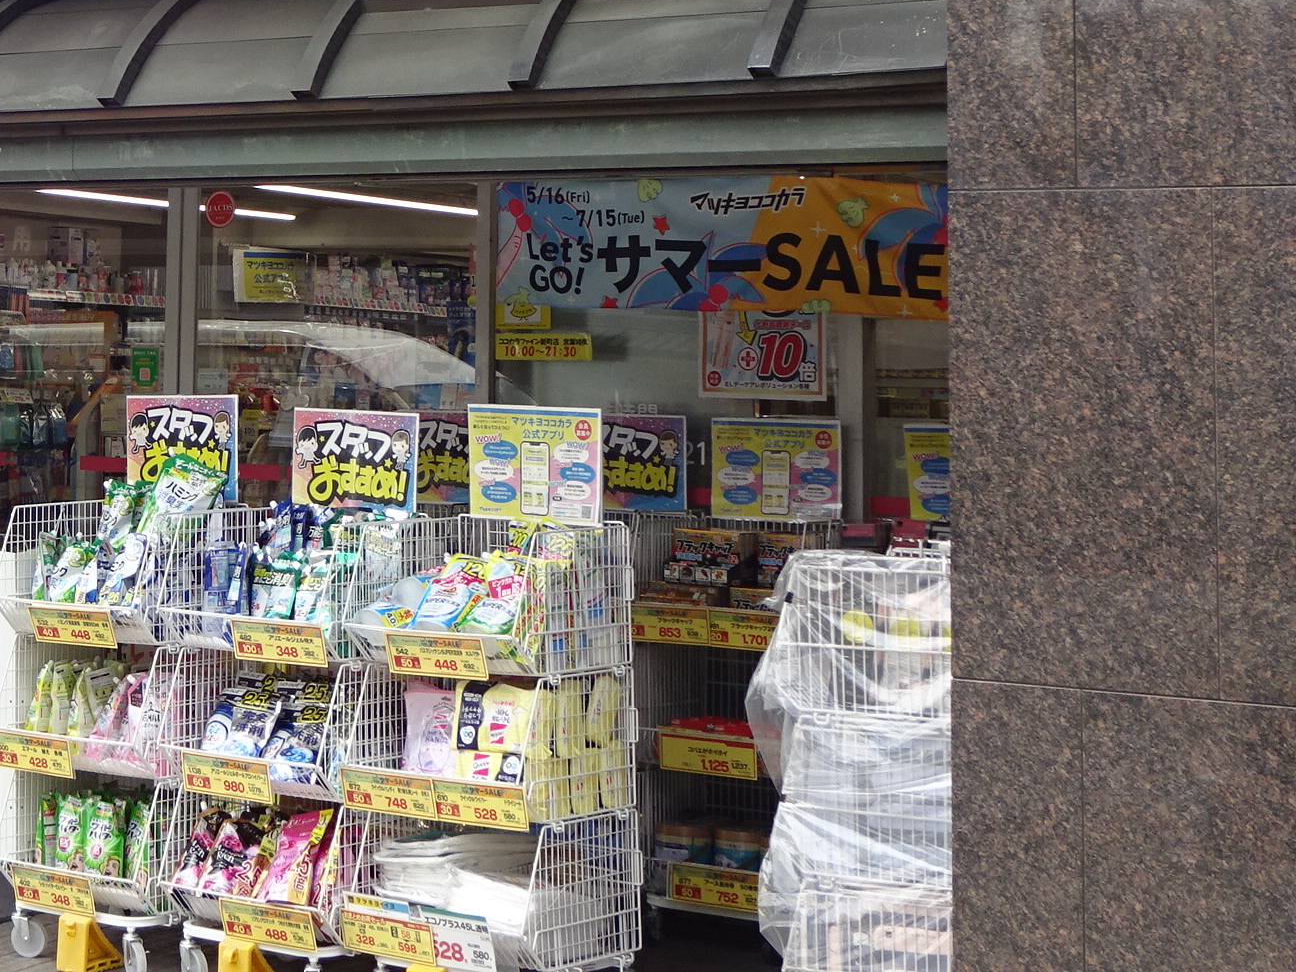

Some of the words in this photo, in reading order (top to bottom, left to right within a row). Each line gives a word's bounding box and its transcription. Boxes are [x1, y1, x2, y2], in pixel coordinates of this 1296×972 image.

[526, 186, 591, 206] 5/16(Fri)
[690, 187, 805, 215] マツキヨココカラ
[527, 233, 593, 263] Let's
[529, 266, 584, 295] GO!
[148, 407, 214, 444] スタッフ
[511, 416, 572, 428] マツキヨココカラ
[475, 433, 502, 444] WOW!
[522, 429, 565, 440] 公式アプリ
[316, 420, 391, 463] スタッフ
[309, 455, 407, 502] おすすめ!
[166, 481, 198, 501] ハミング
[676, 539, 736, 555] ブラックキャップ
[71, 629, 91, 640] 448
[659, 626, 682, 638] 853
[276, 646, 299, 658] 348
[435, 659, 458, 671] 448
[29, 757, 49, 769] 428
[700, 759, 729, 773] 1,125
[223, 780, 245, 793] 980
[384, 796, 408, 810] 748
[474, 808, 498, 821] 528
[50, 893, 71, 906] 348
[716, 890, 739, 904] 752
[265, 928, 288, 941] 488
[355, 934, 375, 946] 328
[398, 941, 418, 954] 598
[473, 950, 490, 960] 580
